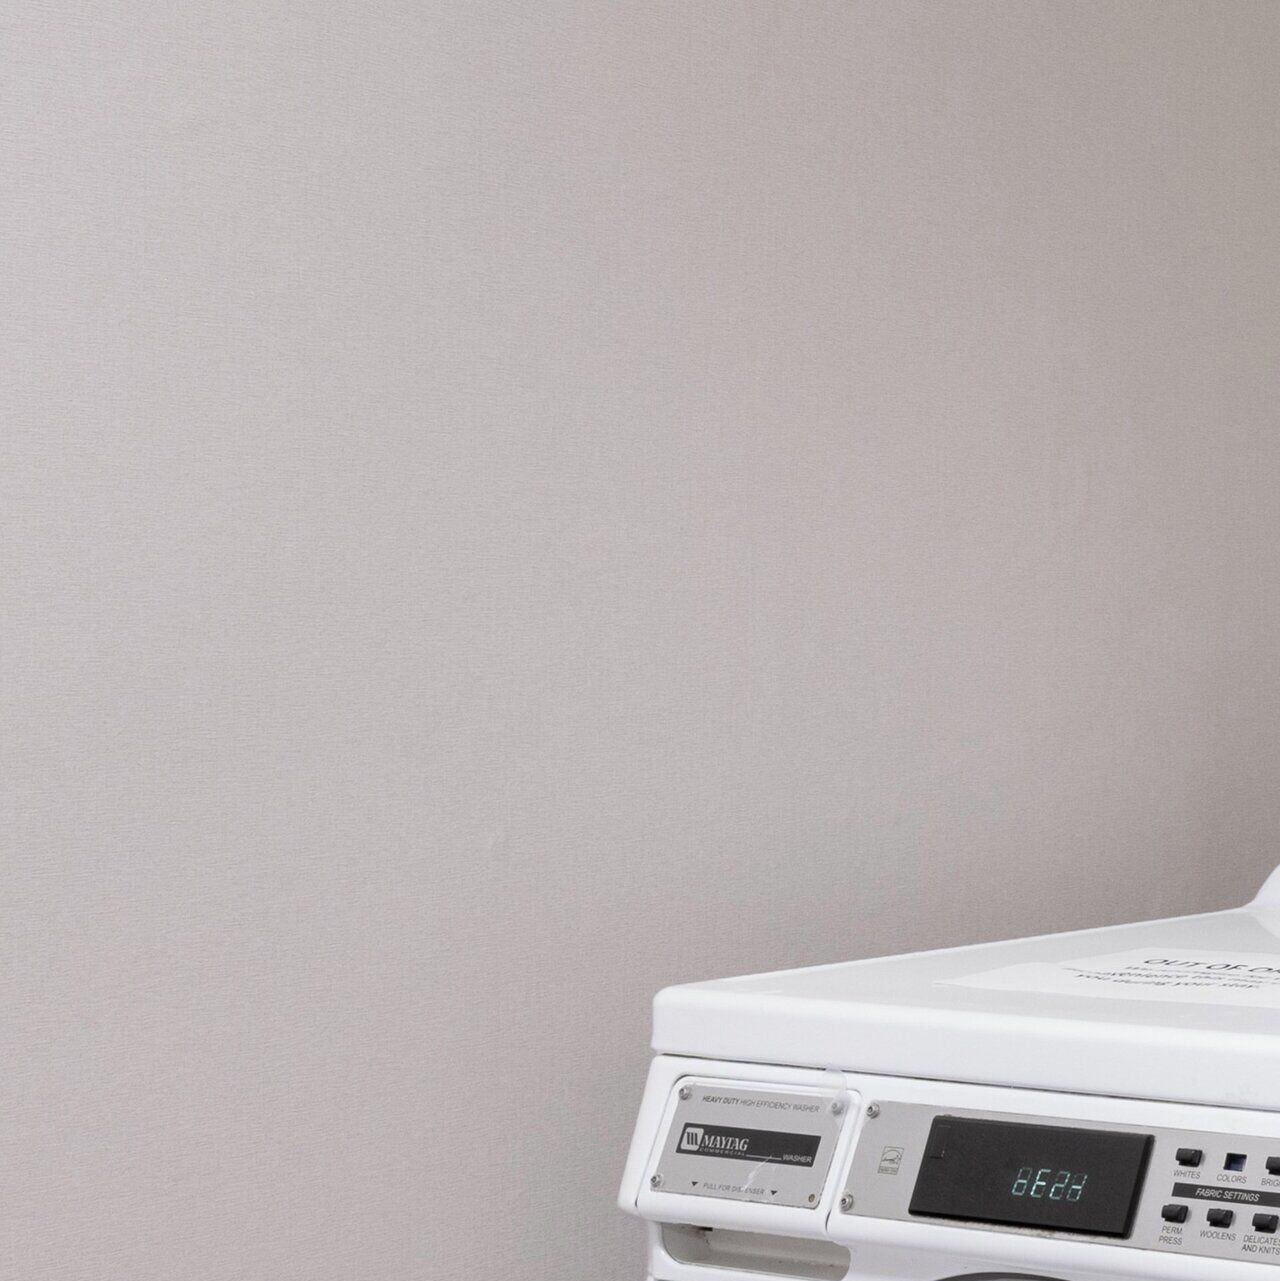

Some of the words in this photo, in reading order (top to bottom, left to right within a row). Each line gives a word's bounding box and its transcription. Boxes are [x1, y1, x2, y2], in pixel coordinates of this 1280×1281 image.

[1144, 958, 1207, 968] OUT
[702, 1095, 722, 1104] HEAVY
[722, 1097, 739, 1105] DUTY
[740, 1098, 756, 1107] HIGH
[756, 1099, 791, 1110] EFFICIENCY
[792, 1103, 820, 1113] WASHER
[701, 1134, 750, 1151] MAYTAG
[700, 1147, 745, 1157] COMMERCIAL
[782, 1153, 812, 1163] WASHER
[1173, 1170, 1201, 1180] WHITES
[1216, 1174, 1248, 1185] COLORS
[703, 1182, 717, 1191] PULL
[731, 1185, 766, 1195] DISENSER
[1194, 1187, 1223, 1199] FABRIC
[1223, 1191, 1260, 1202] SETTINGS
[1158, 1235, 1183, 1246] PRESS
[1199, 1230, 1237, 1241] WOOLENS
[1241, 1244, 1258, 1253] AND
[1258, 1246, 1280, 1256] KNITS
